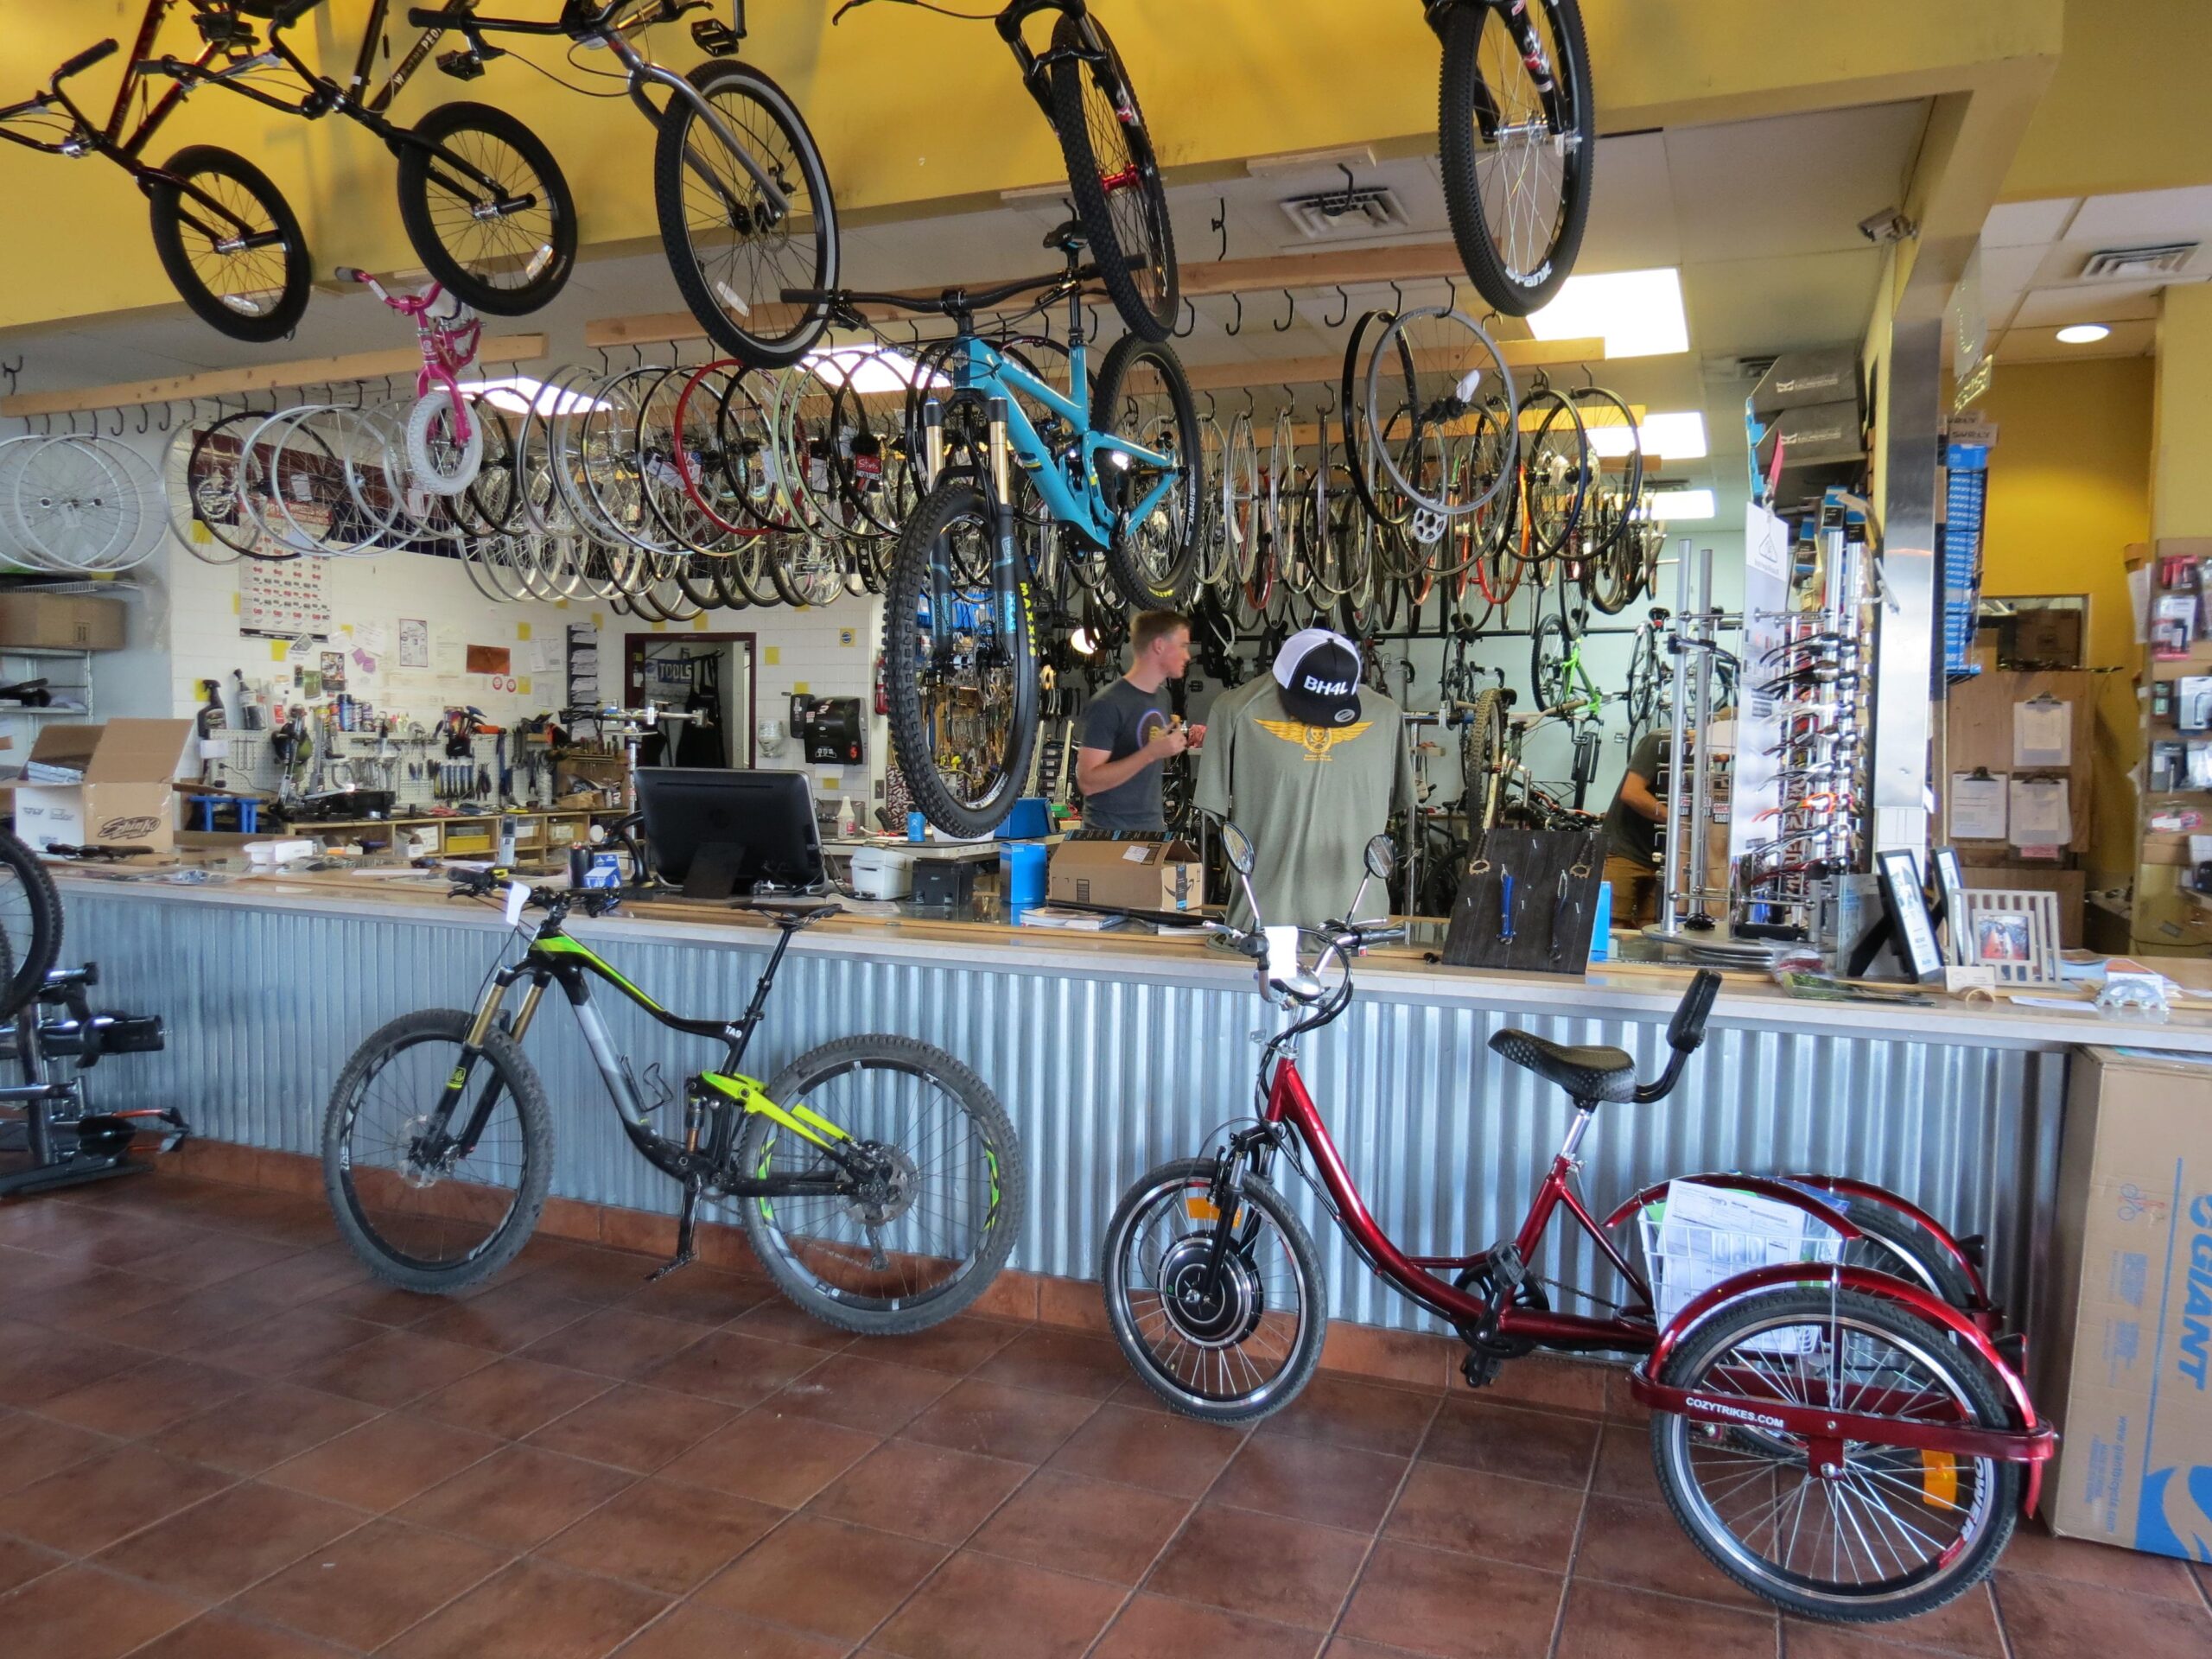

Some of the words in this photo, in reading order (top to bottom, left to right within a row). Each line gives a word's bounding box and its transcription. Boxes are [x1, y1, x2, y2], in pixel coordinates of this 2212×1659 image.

[1019, 582, 1037, 658] MAXXIS
[659, 663, 692, 680] TOOLS
[1303, 675, 1349, 696] BH4L
[2178, 1233, 2212, 1391] GIANT
[1686, 1396, 1785, 1428] COZYTRIKES.COM
[1960, 1456, 1986, 1542] OWER
